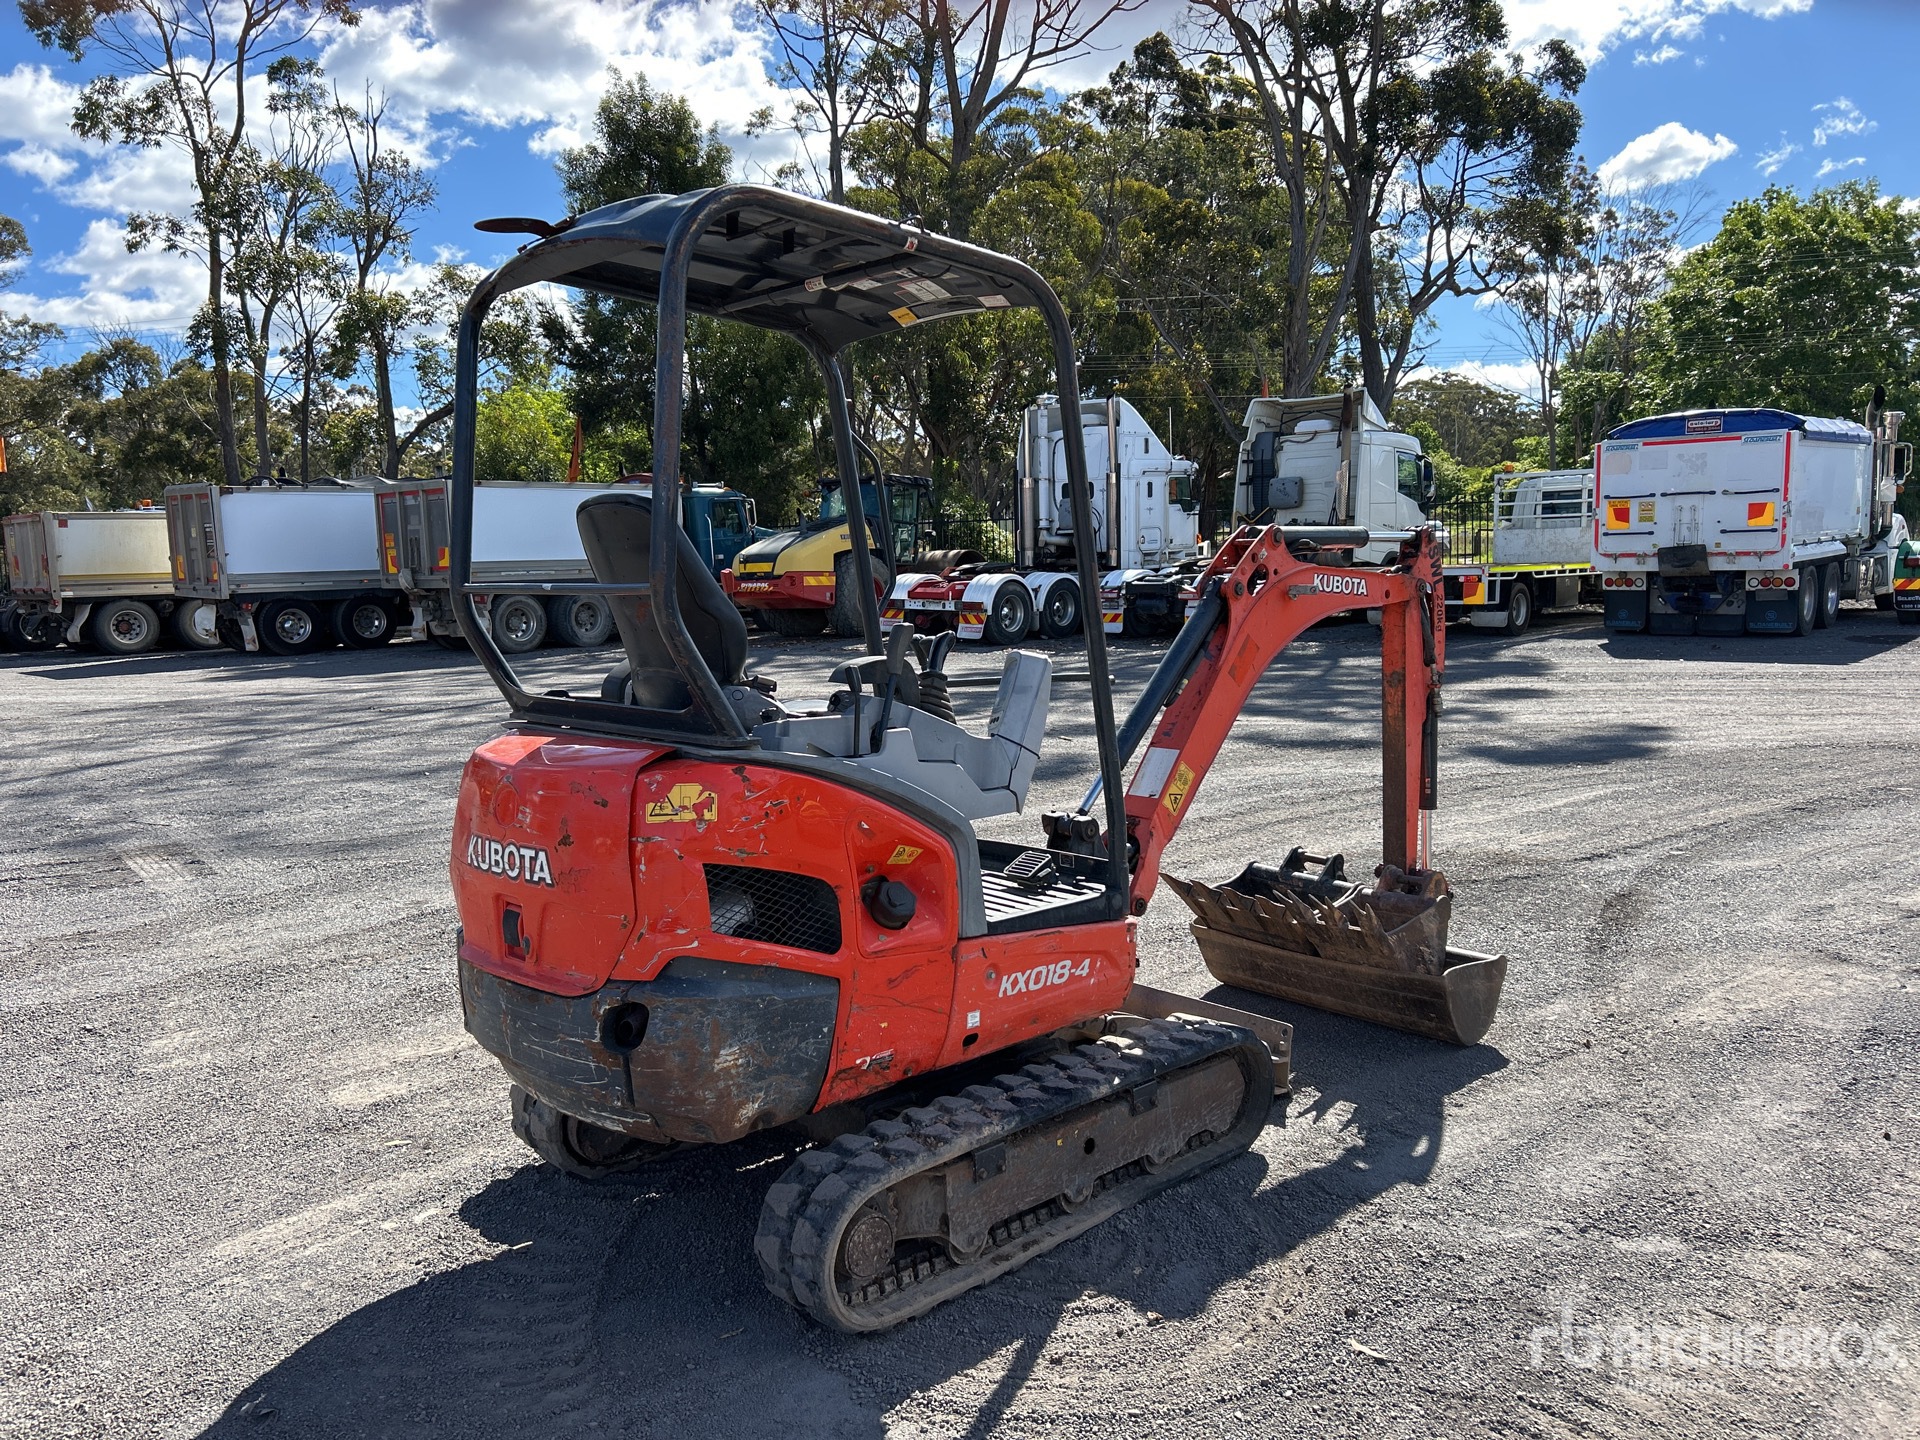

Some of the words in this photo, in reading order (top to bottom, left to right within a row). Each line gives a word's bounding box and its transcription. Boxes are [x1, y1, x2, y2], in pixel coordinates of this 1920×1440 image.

[1313, 573, 1367, 596] KUBOTA
[1428, 544, 1443, 592] SWL
[1435, 593, 1444, 632] 220kg
[467, 834, 554, 886] KUBOTA
[998, 958, 1091, 998] KX018-4
